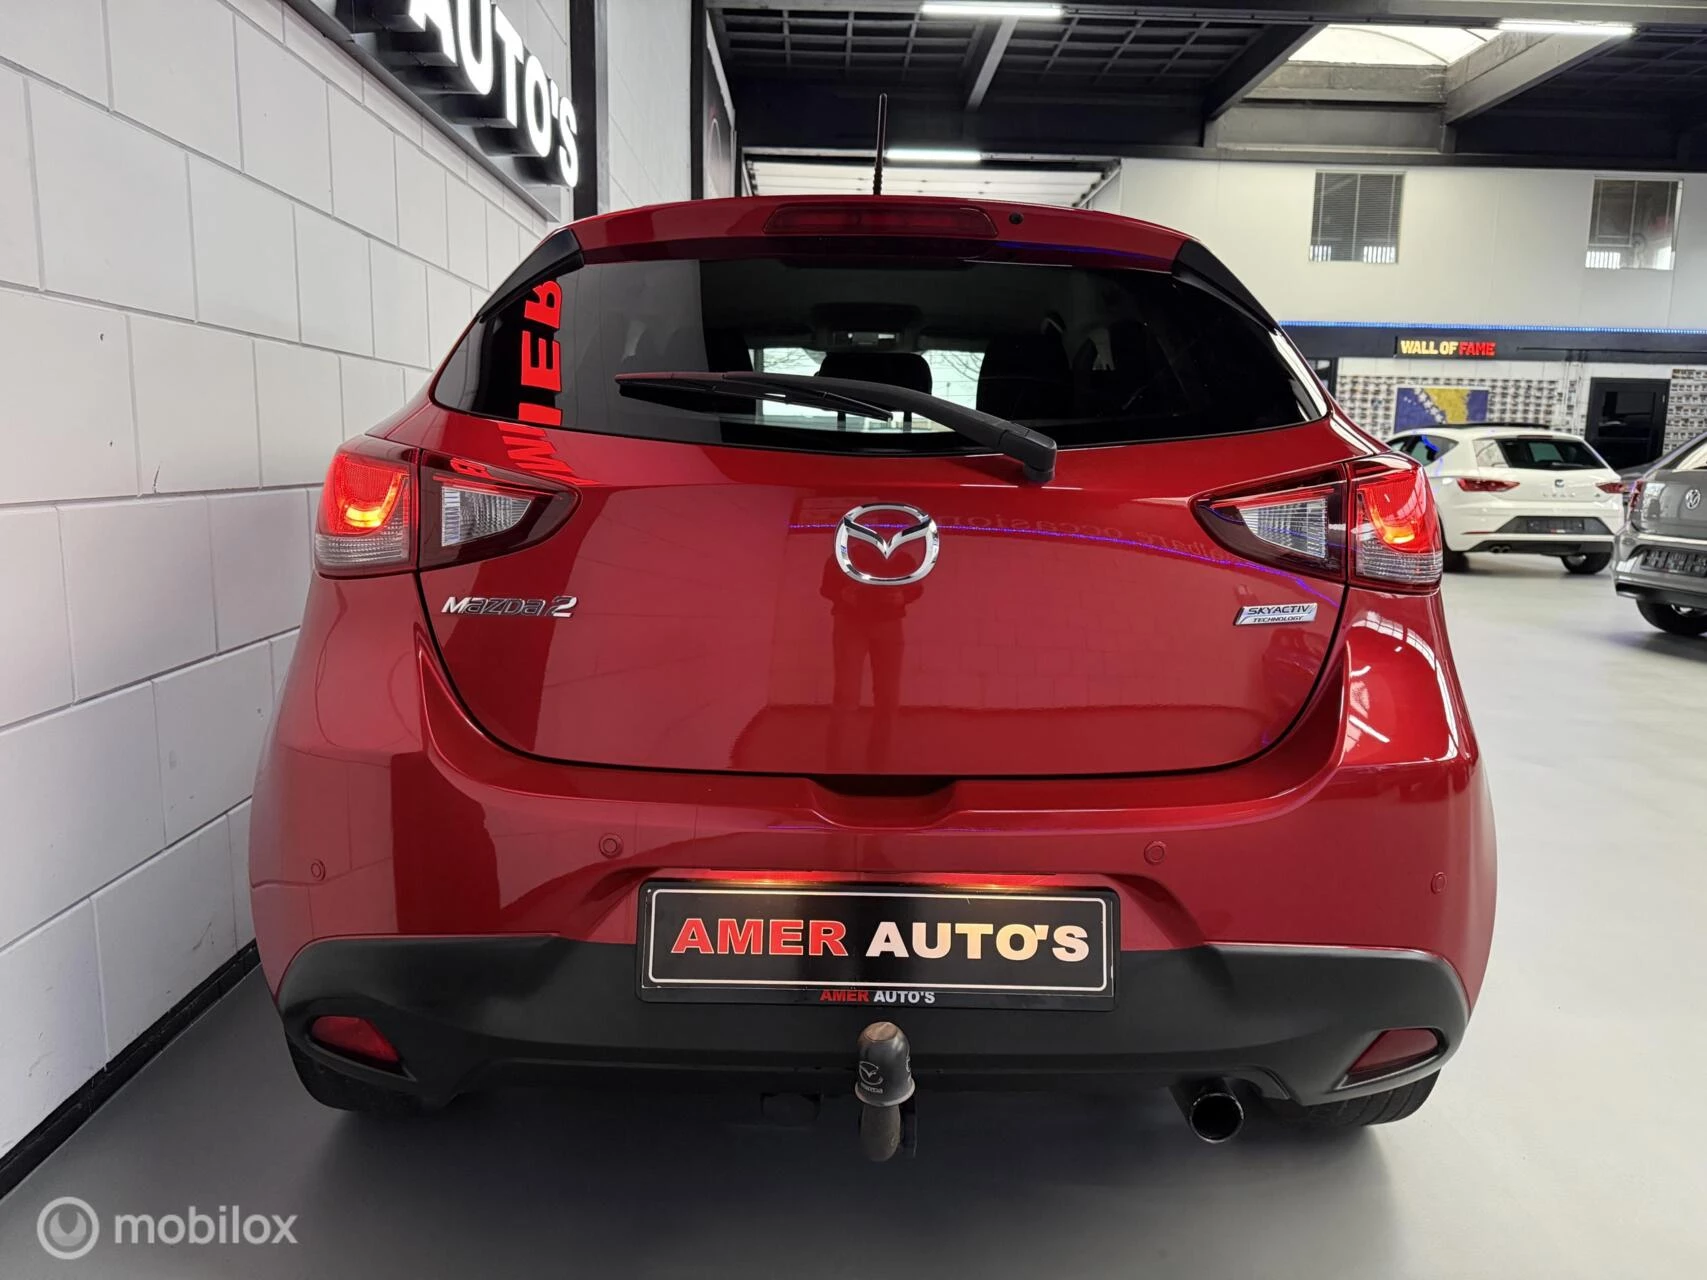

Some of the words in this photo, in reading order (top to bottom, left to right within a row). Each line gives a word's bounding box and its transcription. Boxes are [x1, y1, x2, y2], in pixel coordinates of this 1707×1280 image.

[1400, 340, 1439, 355] WALL
[1439, 341, 1458, 355] OF
[1458, 342, 1496, 356] FAME
[1247, 605, 1310, 615] SKYACTIV
[1252, 615, 1304, 623] TECHNOLOGY
[671, 917, 849, 957] AMER
[865, 921, 1090, 962] AUTO'S
[820, 988, 869, 1002] AMER
[873, 990, 936, 1004] AUTO'S
